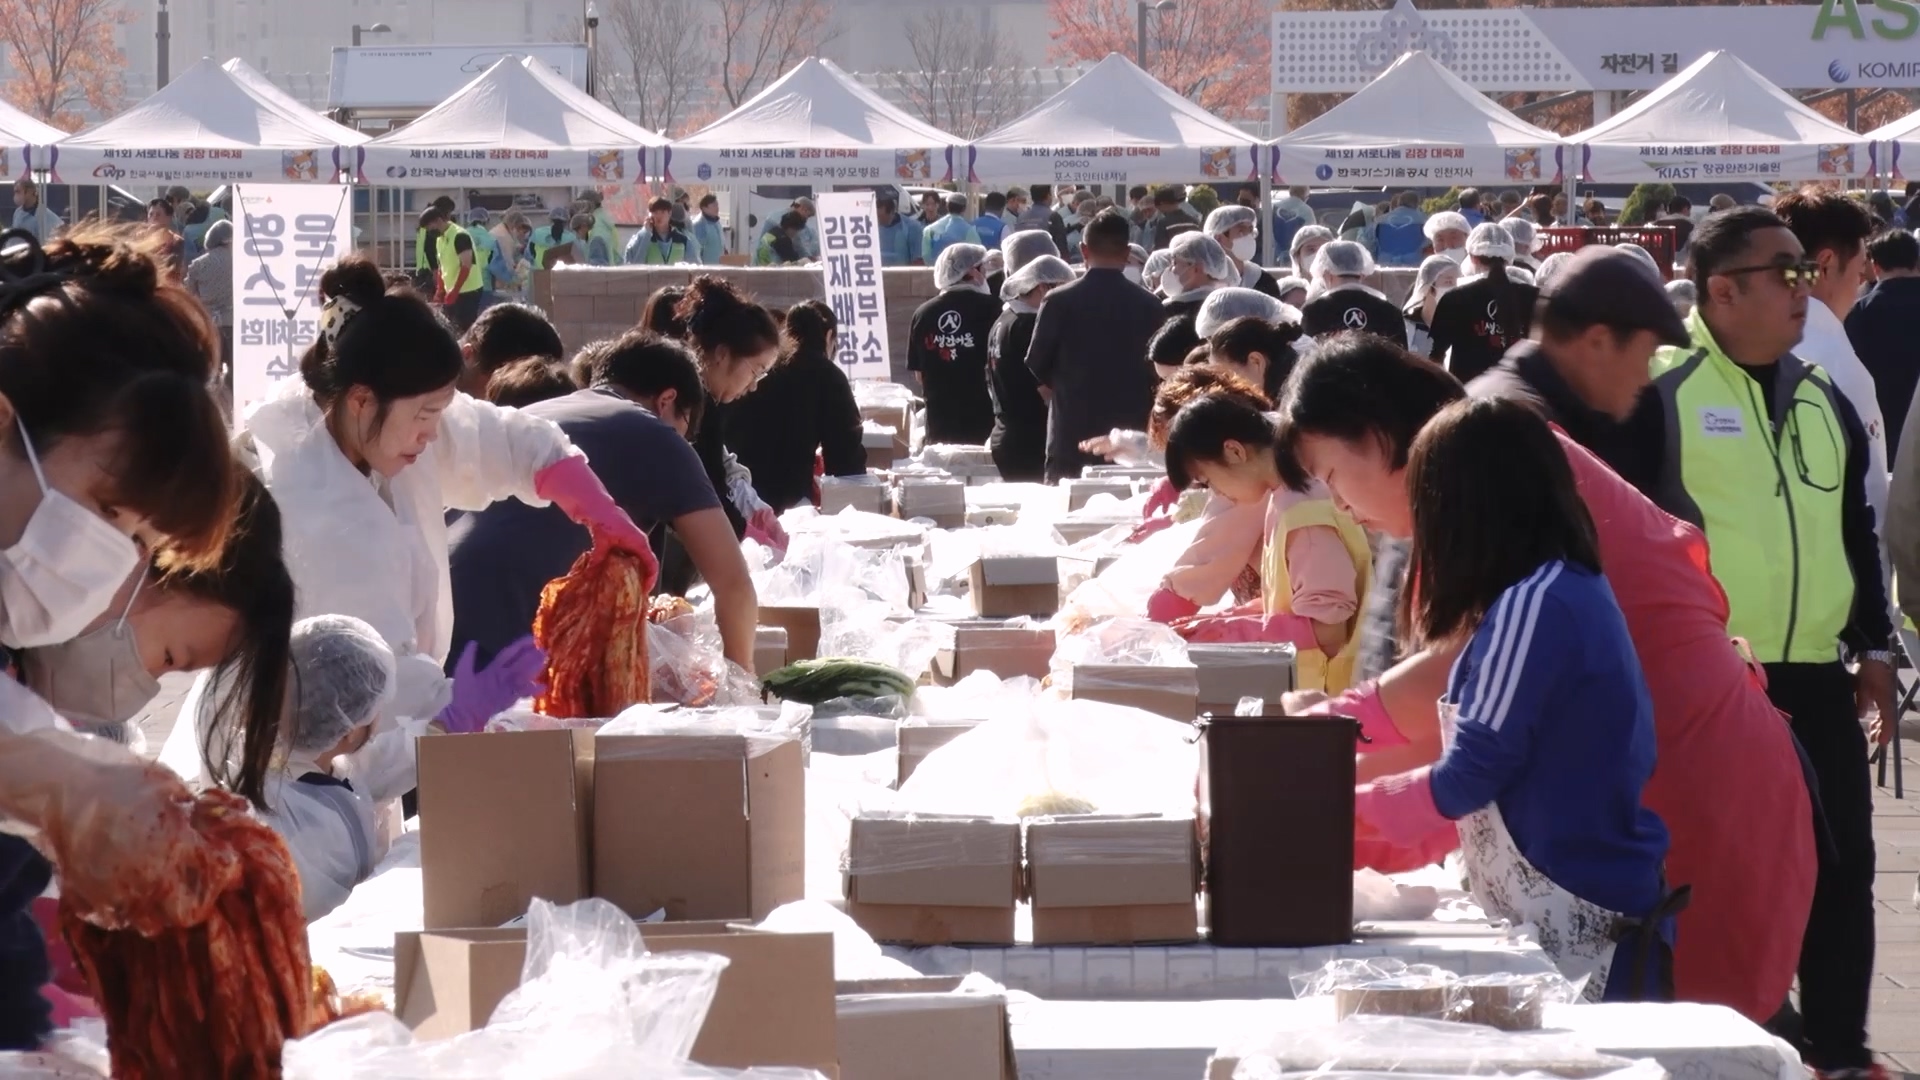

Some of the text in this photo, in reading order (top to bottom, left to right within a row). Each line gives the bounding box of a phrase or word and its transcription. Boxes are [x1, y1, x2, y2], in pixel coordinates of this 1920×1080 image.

[1811, 0, 1920, 40] AS
[1600, 53, 1679, 74] 자전거 길
[103, 148, 243, 160] 제1회 서로나눔 김장 대축제
[409, 148, 549, 160] 제1회 서로나눔 김장 대축제
[719, 148, 859, 159] 제1회 서로나눔 김장 대축제
[1021, 146, 1161, 158] 제1회 서로나눔 김장 대축제
[1324, 147, 1465, 159] 제1회 서로나눔 김장 대축제
[1639, 145, 1781, 157] 제1회 서로나눔 김장 대축제
[717, 167, 880, 178] 가톨릭관동대학교 국제성모병원
[1337, 167, 1474, 178] 한국가스기술공사 인천지사
[1658, 167, 1698, 179] KIAST
[1702, 162, 1781, 175] 항공안전기술원
[824, 215, 873, 250] 김장
[827, 253, 877, 288] 재료
[831, 292, 879, 326] 배부
[837, 330, 883, 365] 장소
